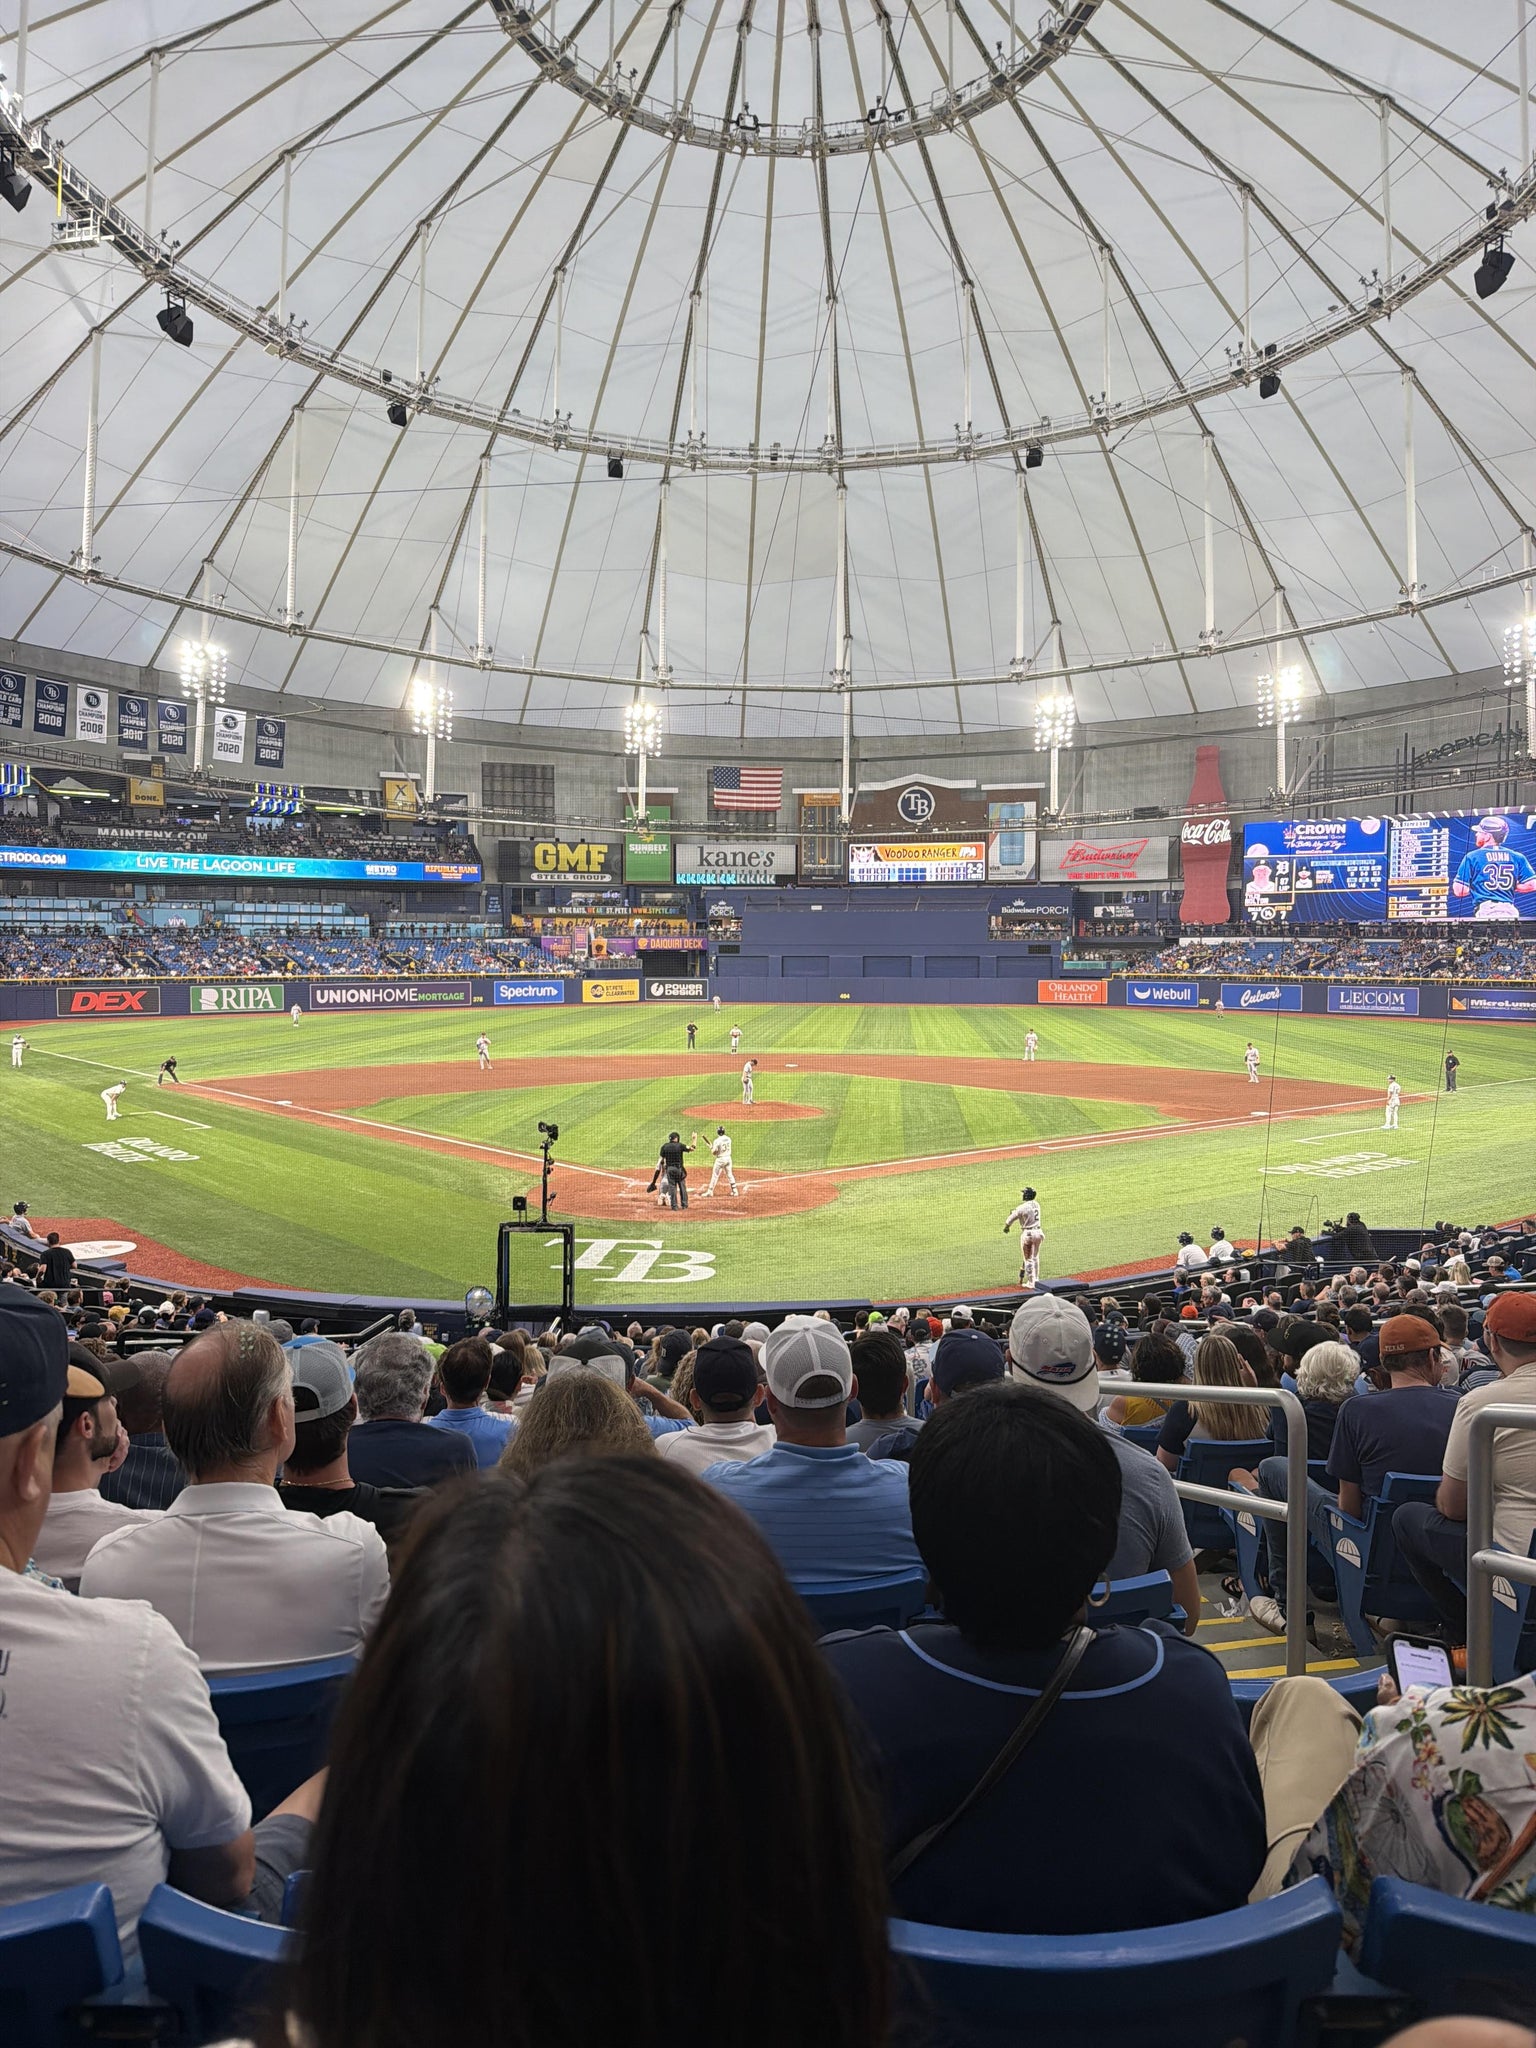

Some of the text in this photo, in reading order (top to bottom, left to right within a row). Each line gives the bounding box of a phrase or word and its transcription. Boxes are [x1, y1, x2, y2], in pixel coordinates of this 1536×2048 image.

[37, 703, 65, 713] CHAMPIONS
[38, 713, 62, 727] 2008
[79, 711, 106, 721] CHAMPIONS
[80, 721, 104, 734] 2008
[120, 717, 146, 728] CHAMPIONS
[160, 723, 186, 732] CHAMPIONS
[123, 728, 143, 741] 2010
[162, 734, 183, 746] 2020
[216, 732, 242, 742] CHAMPIONS
[218, 742, 240, 755] 2020
[256, 739, 283, 748] CHAMPIONS
[1414, 727, 1528, 769] TROPICAN
[260, 749, 280, 760] 2021
[135, 795, 160, 803] DONE.
[905, 794, 929, 816] TB
[1296, 824, 1346, 835] CROWN
[534, 843, 609, 872] GMF
[698, 846, 776, 868] kane's
[885, 848, 919, 859] VOODOO
[922, 848, 957, 858] RANGER
[1068, 848, 1140, 862] Budweiser
[1486, 852, 1510, 862] DUNN
[137, 856, 296, 874] LIVE THE LAGOON LIFE
[425, 865, 478, 874] REPUBLIC BANK
[1483, 864, 1514, 890] 35
[1002, 906, 1068, 914] Budweiser PORCH
[650, 938, 703, 949] DAIQUIRI DECK
[500, 985, 554, 1001] Spectrum
[1048, 983, 1098, 992] ORLANDO
[221, 987, 277, 1011] RIPA
[418, 992, 465, 1001] MORTGAGE
[1054, 992, 1092, 1001] HEALTH
[1152, 988, 1191, 1000] Webull
[1240, 987, 1282, 1007] Culver's
[70, 991, 148, 1012] DEX
[544, 1238, 717, 1283] TB
[1384, 1344, 1405, 1352] TEXAS
